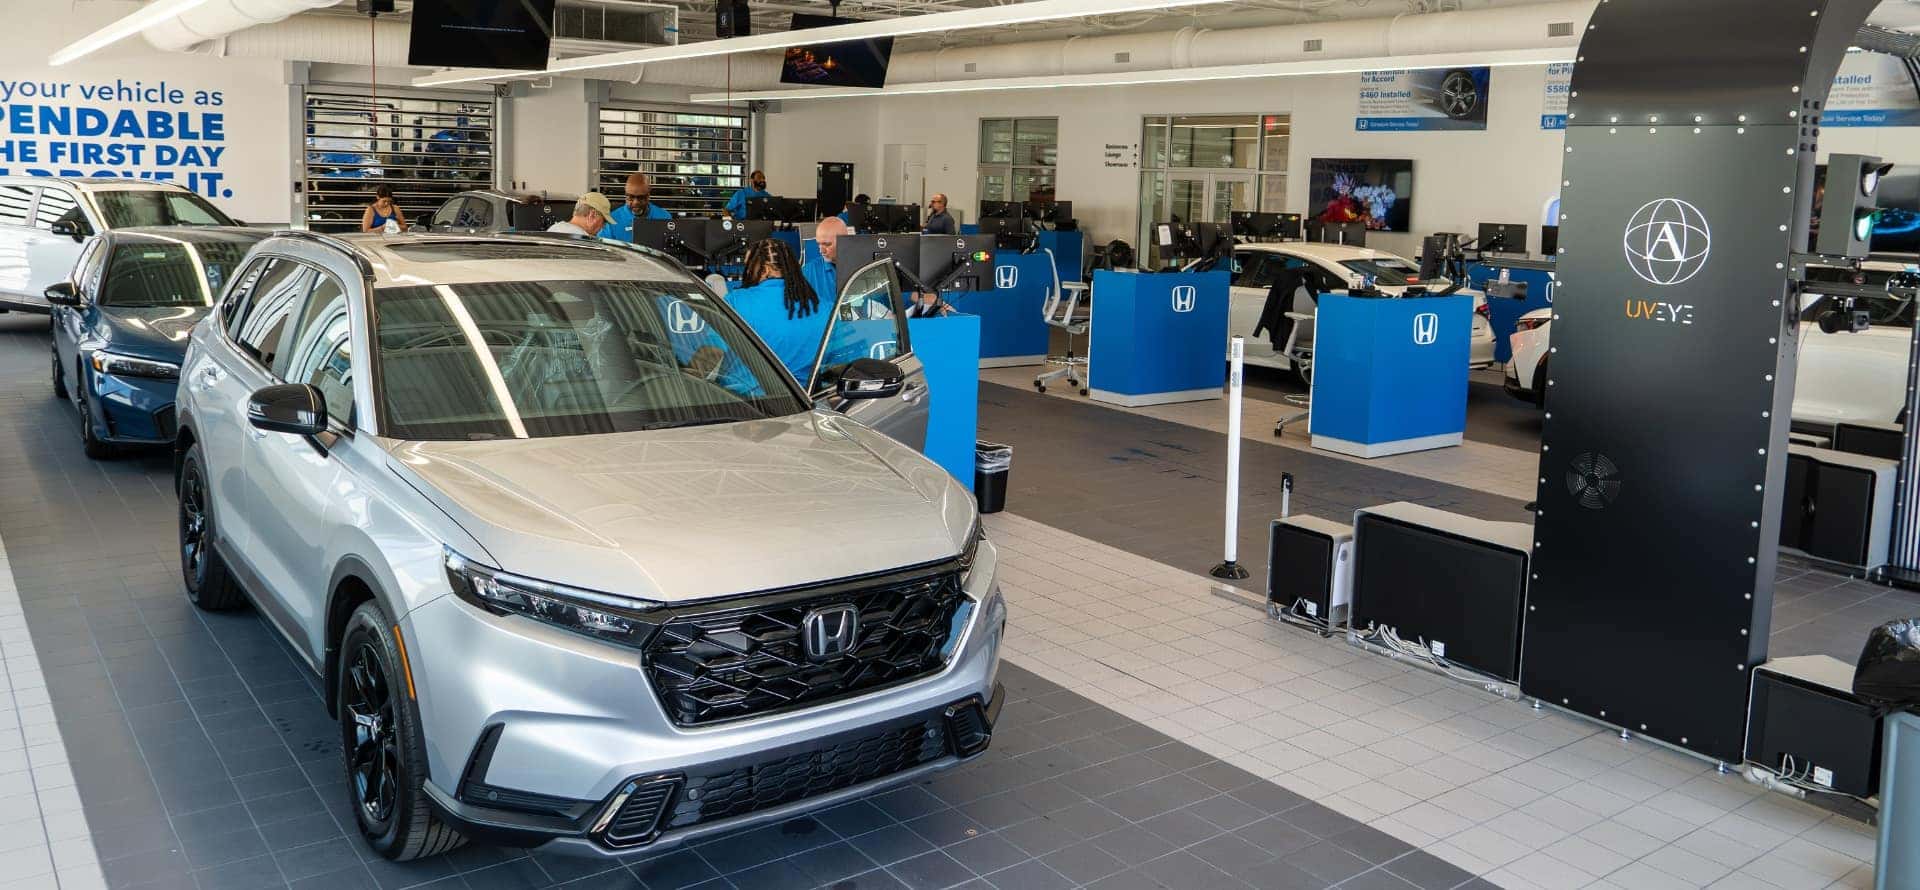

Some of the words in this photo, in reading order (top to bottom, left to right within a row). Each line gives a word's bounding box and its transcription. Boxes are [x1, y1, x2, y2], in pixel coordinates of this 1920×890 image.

[1372, 75, 1395, 83] Accord
[0, 80, 70, 102] your
[80, 79, 184, 104] vehicle
[194, 90, 223, 106] as
[1380, 90, 1411, 98] Installed
[0, 104, 224, 141] ENDABLE
[50, 142, 145, 165] FIRST
[156, 145, 226, 167] DAY
[189, 172, 233, 198] IT.
